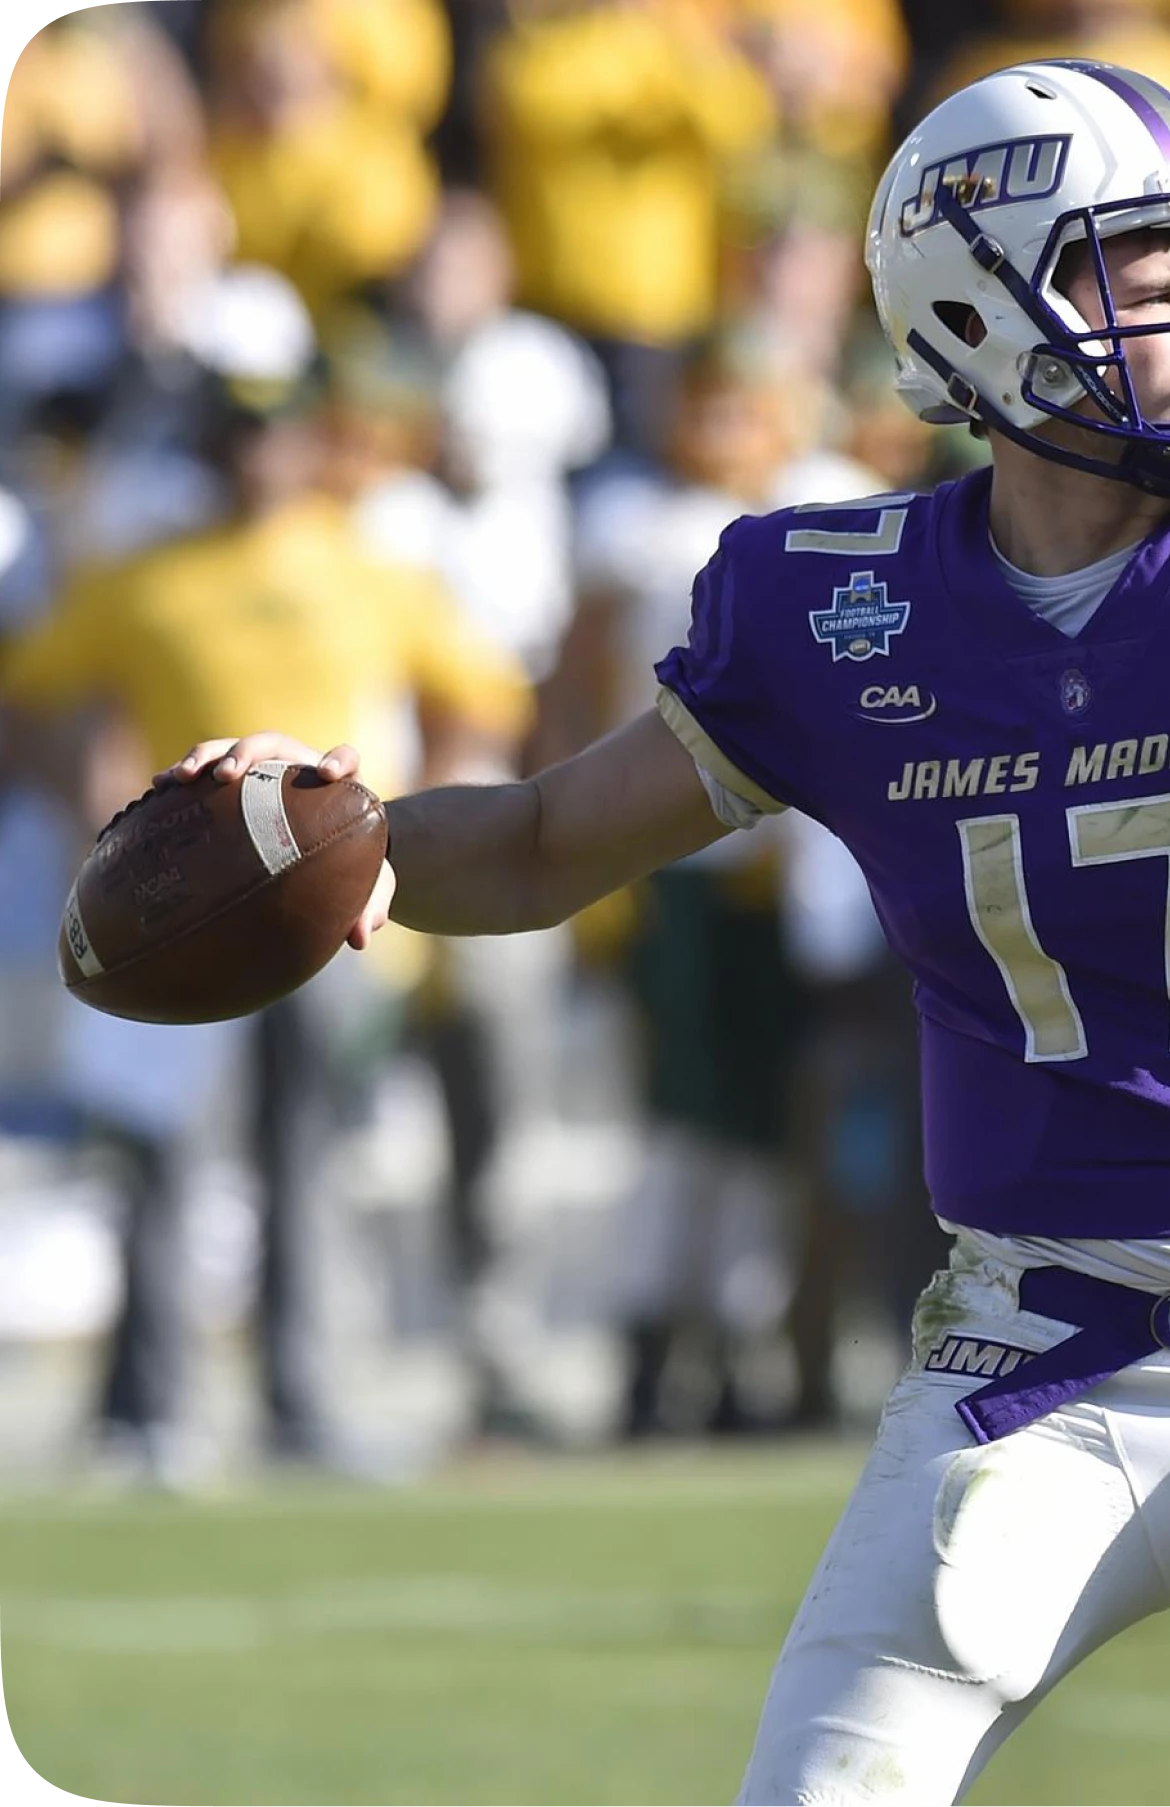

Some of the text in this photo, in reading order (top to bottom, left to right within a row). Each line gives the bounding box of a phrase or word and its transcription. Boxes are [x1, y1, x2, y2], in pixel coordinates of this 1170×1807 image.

[901, 134, 1073, 237] JMU
[821, 612, 899, 632] CHAMPIONSHIP
[840, 605, 879, 618] FOOTBALL
[860, 685, 921, 708] CAA
[887, 752, 1040, 801] JAMES
